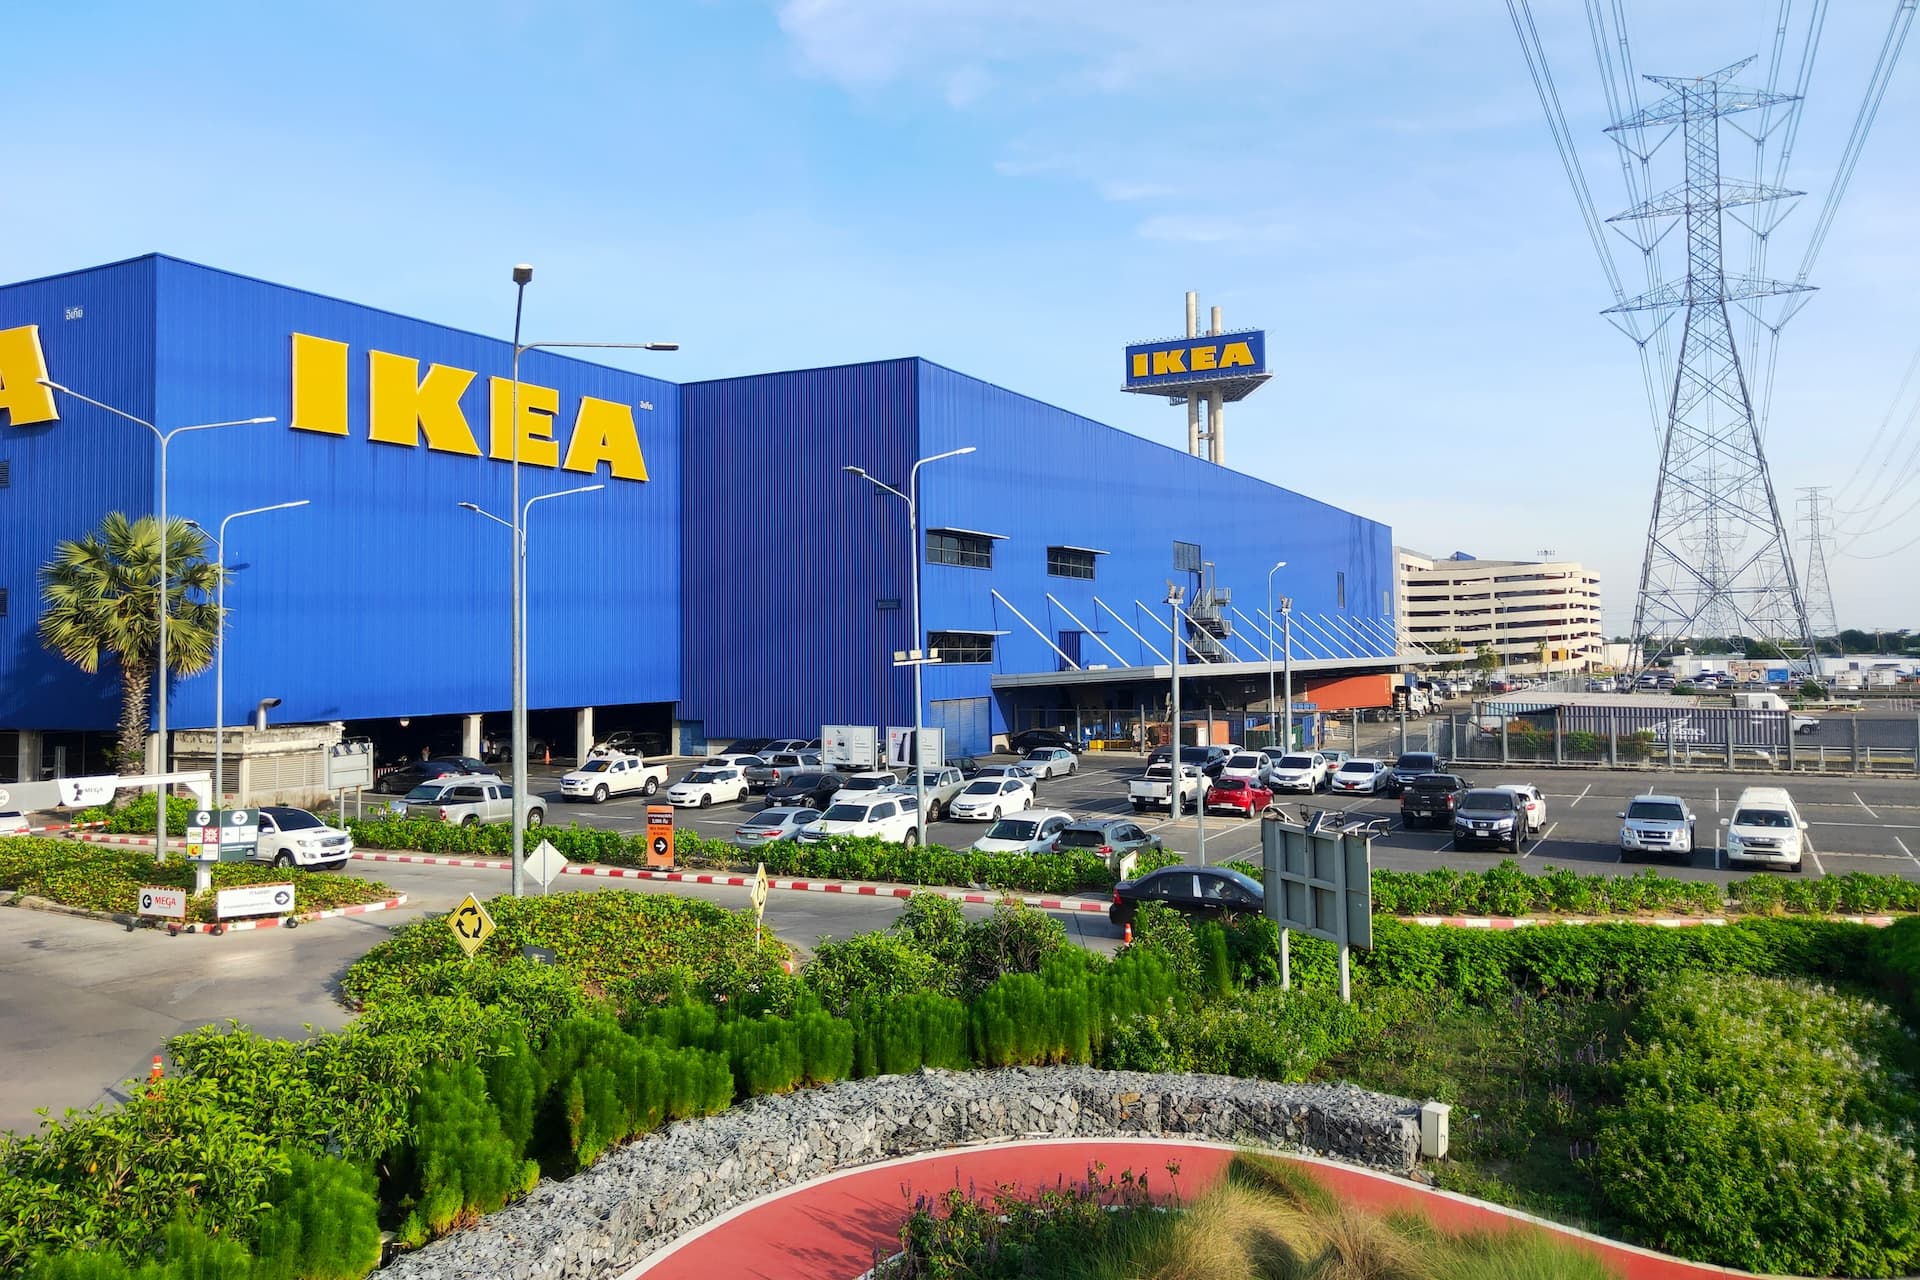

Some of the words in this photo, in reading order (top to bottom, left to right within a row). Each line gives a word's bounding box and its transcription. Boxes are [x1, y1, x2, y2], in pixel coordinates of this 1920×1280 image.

[1133, 342, 1255, 377] IKEA
[289, 332, 650, 482] IKEA
[154, 896, 177, 909] MEGA
